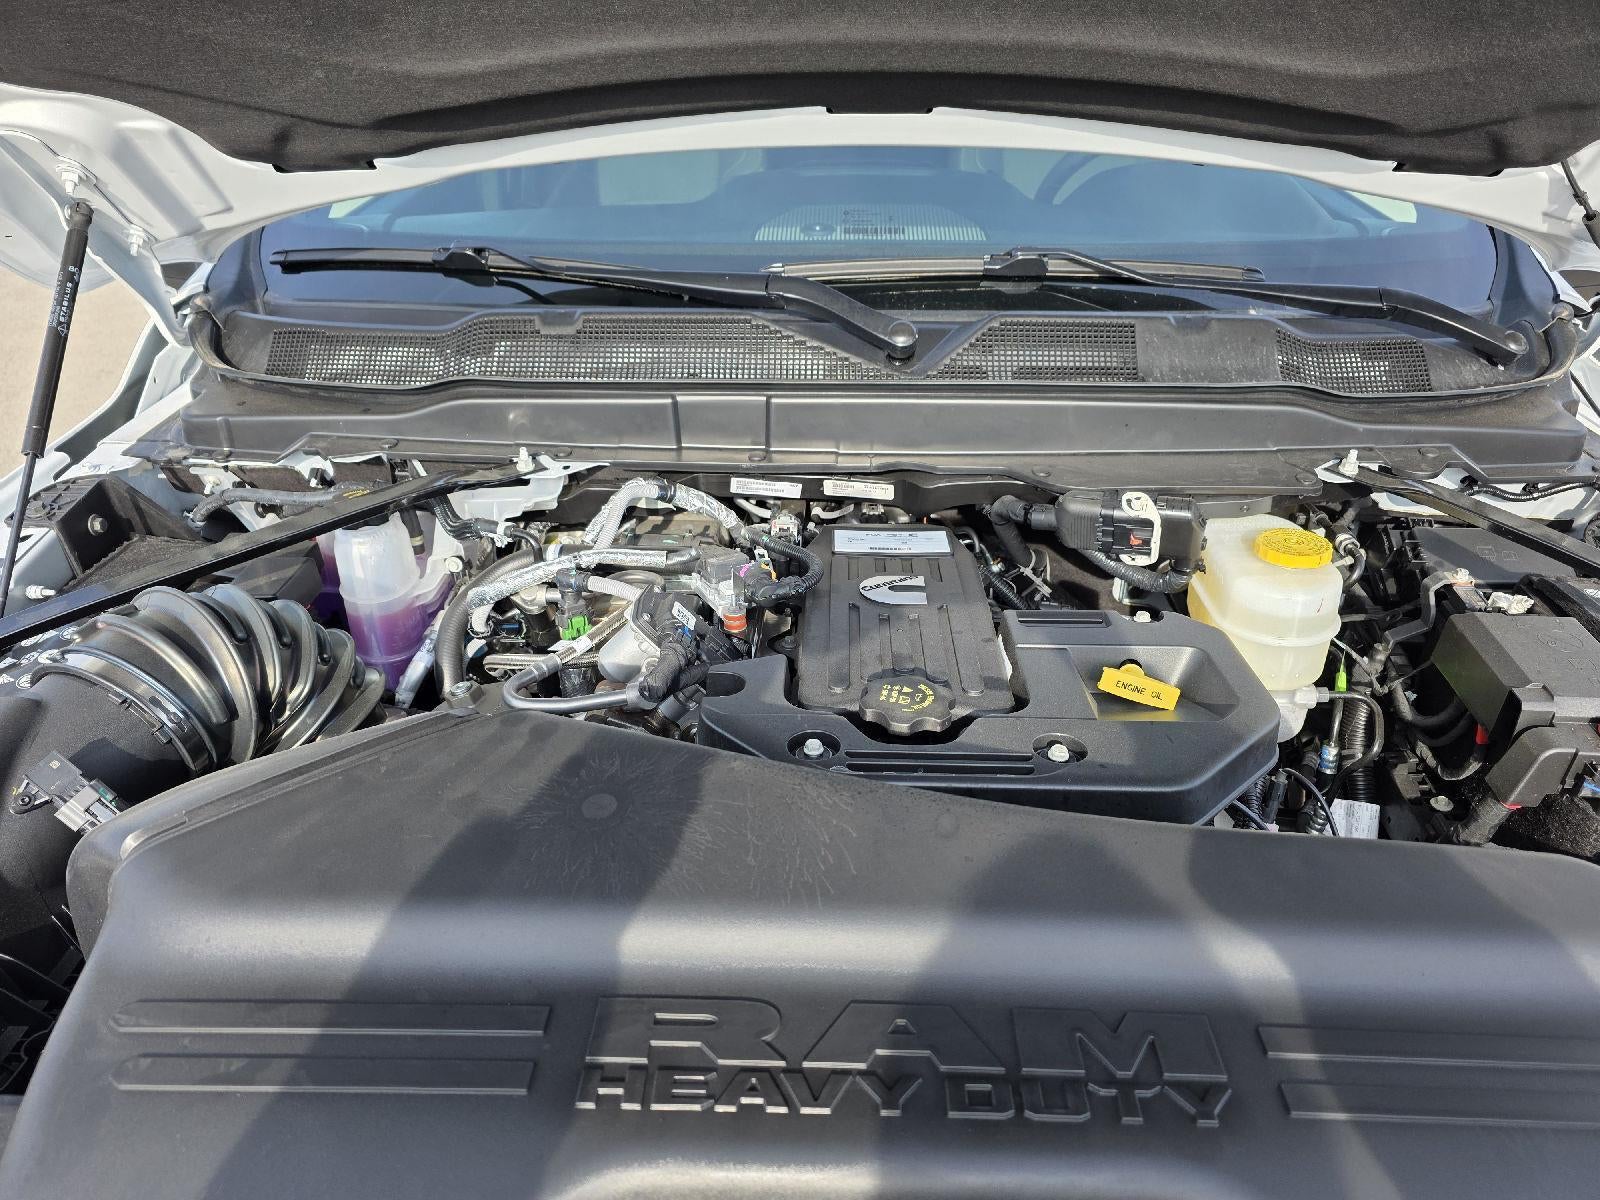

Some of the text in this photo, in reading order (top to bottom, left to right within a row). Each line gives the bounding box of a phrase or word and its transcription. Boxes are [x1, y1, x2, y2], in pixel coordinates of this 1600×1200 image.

[60, 281, 73, 323] STABILUS
[860, 575, 919, 593] Cummins
[1115, 680, 1163, 700] ENGINE OIL
[584, 994, 1229, 1082] RAM
[574, 1064, 1232, 1128] HEAVY DUTY
